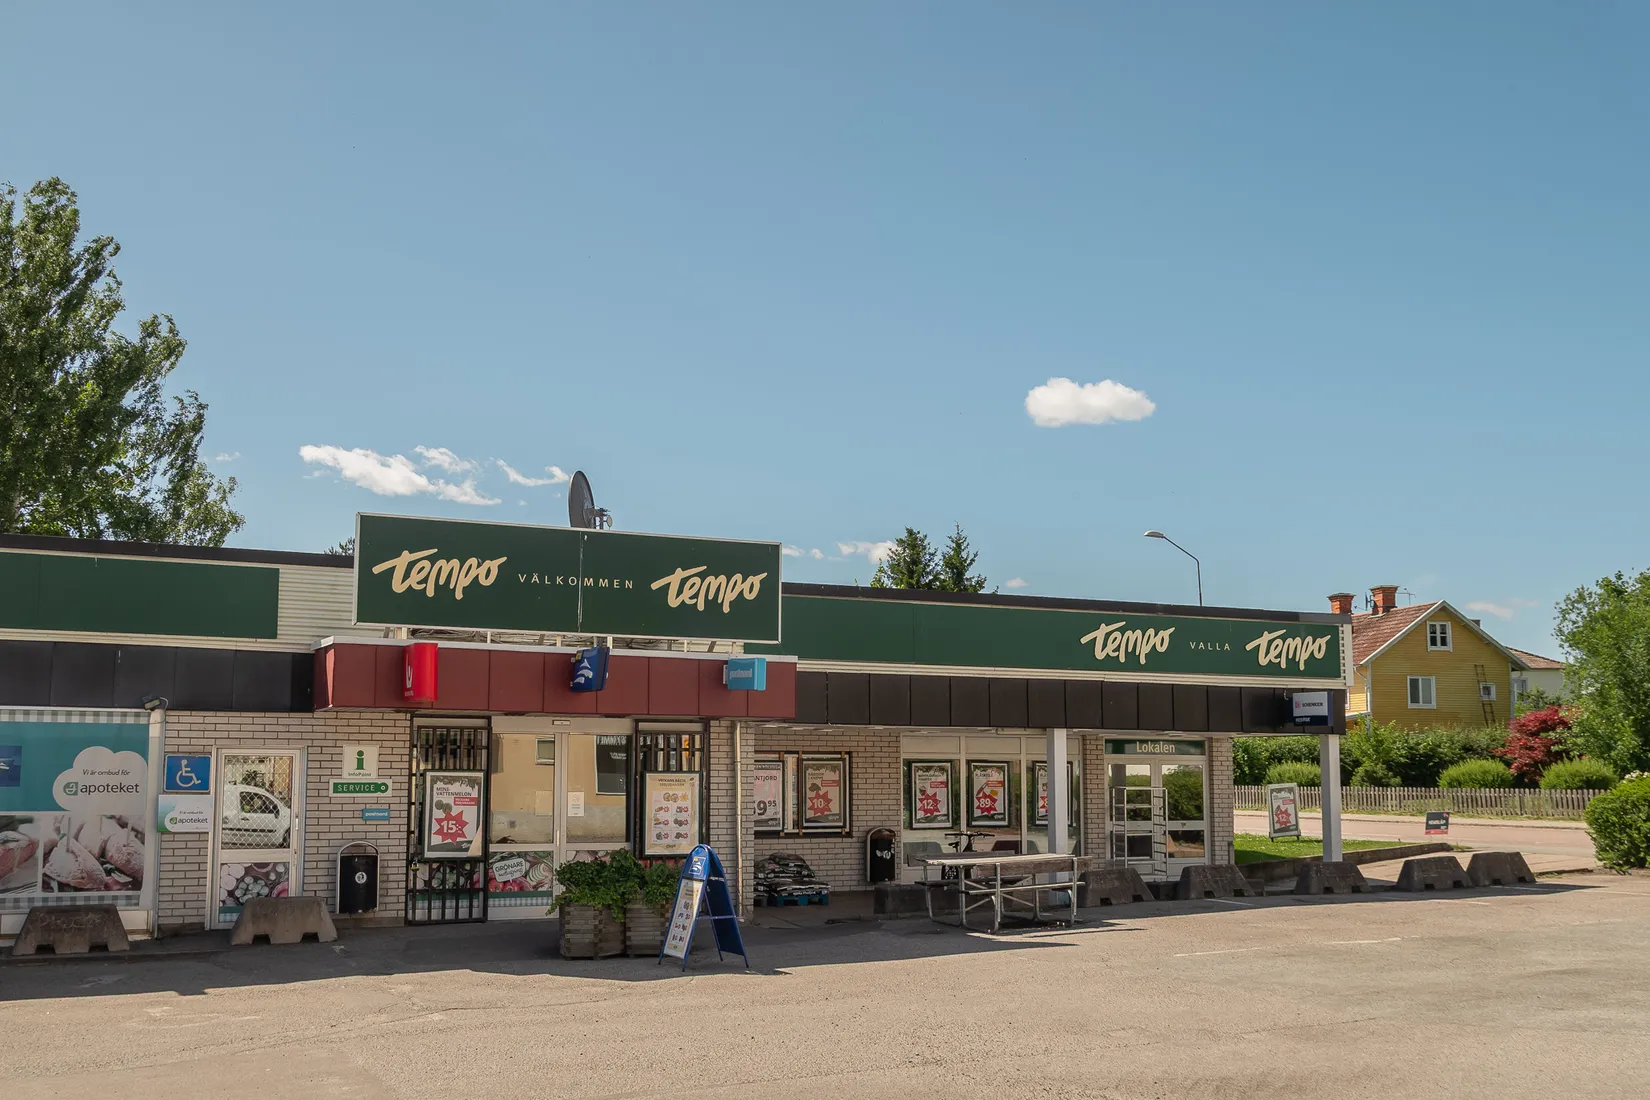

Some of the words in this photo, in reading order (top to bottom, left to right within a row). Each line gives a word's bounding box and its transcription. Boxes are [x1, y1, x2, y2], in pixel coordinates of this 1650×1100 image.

[518, 572, 634, 589] VÄLKOMMEN
[1189, 641, 1231, 651] VALLA
[1136, 741, 1176, 753] Lokalen
[80, 782, 140, 795] apoteket
[337, 784, 376, 792] SERVICE
[178, 817, 208, 825] apoteket
